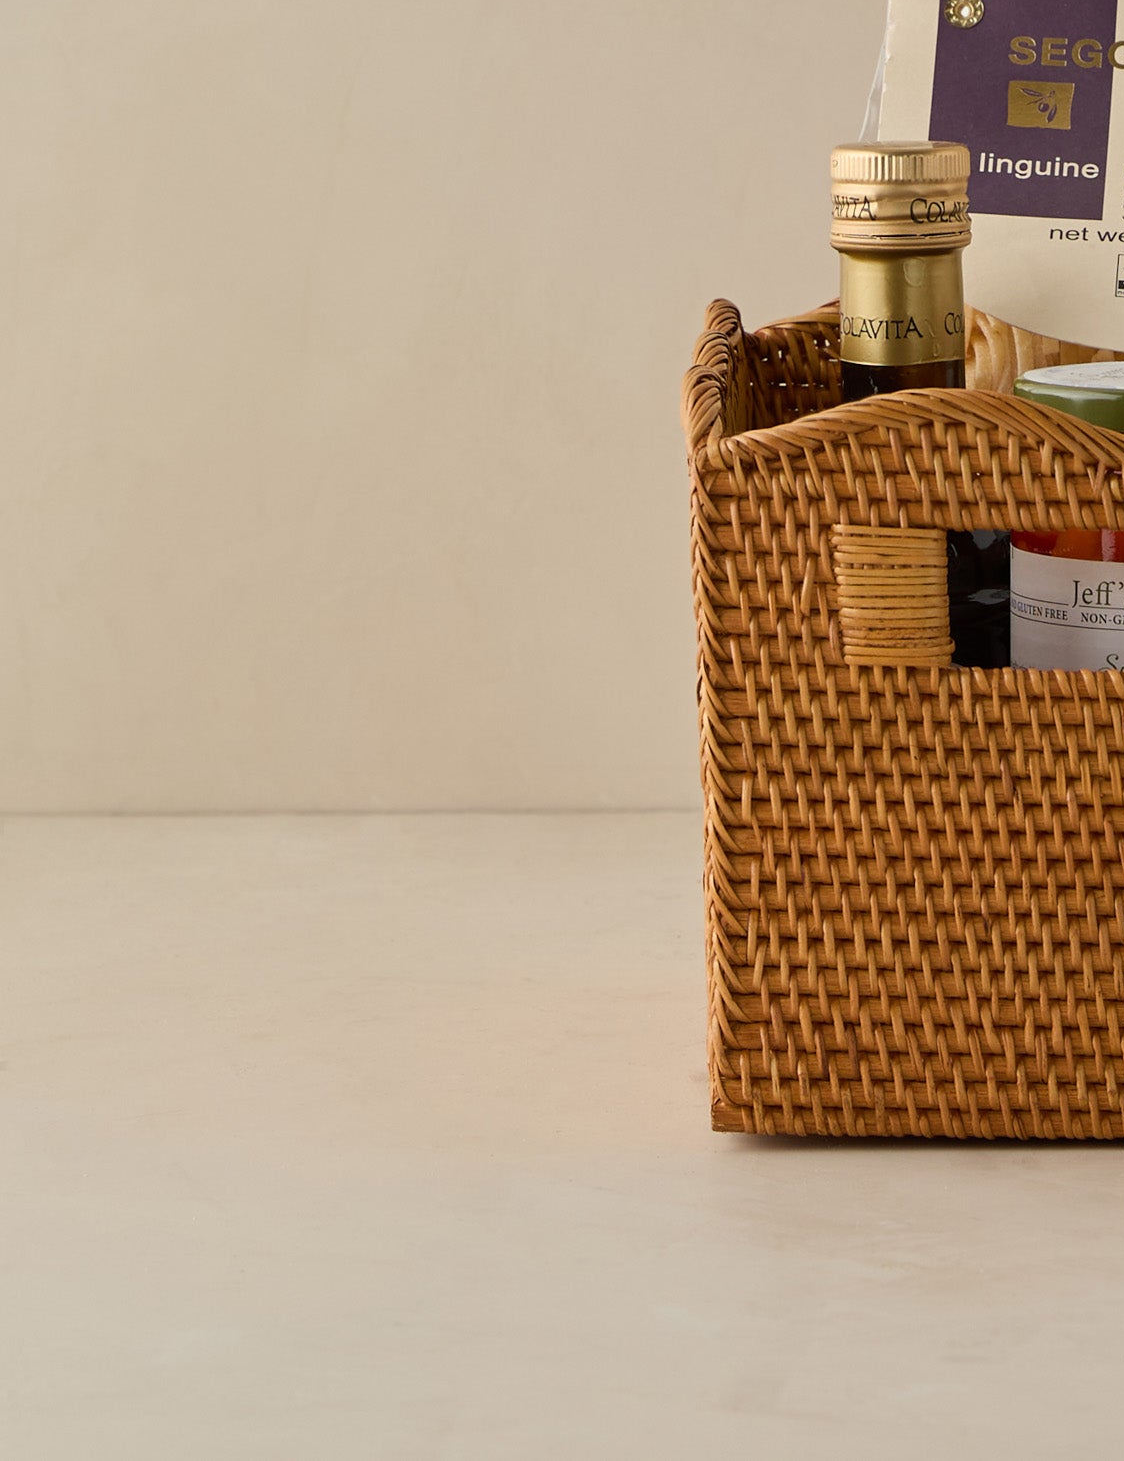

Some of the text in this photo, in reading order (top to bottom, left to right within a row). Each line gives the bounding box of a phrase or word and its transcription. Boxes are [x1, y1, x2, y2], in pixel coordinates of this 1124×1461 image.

[978, 152, 1100, 181] linguine
[1049, 226, 1089, 243] net
[840, 313, 924, 340] OLAVITA
[1017, 601, 1043, 618] GLUTEN
[1045, 609, 1068, 621] FREE
